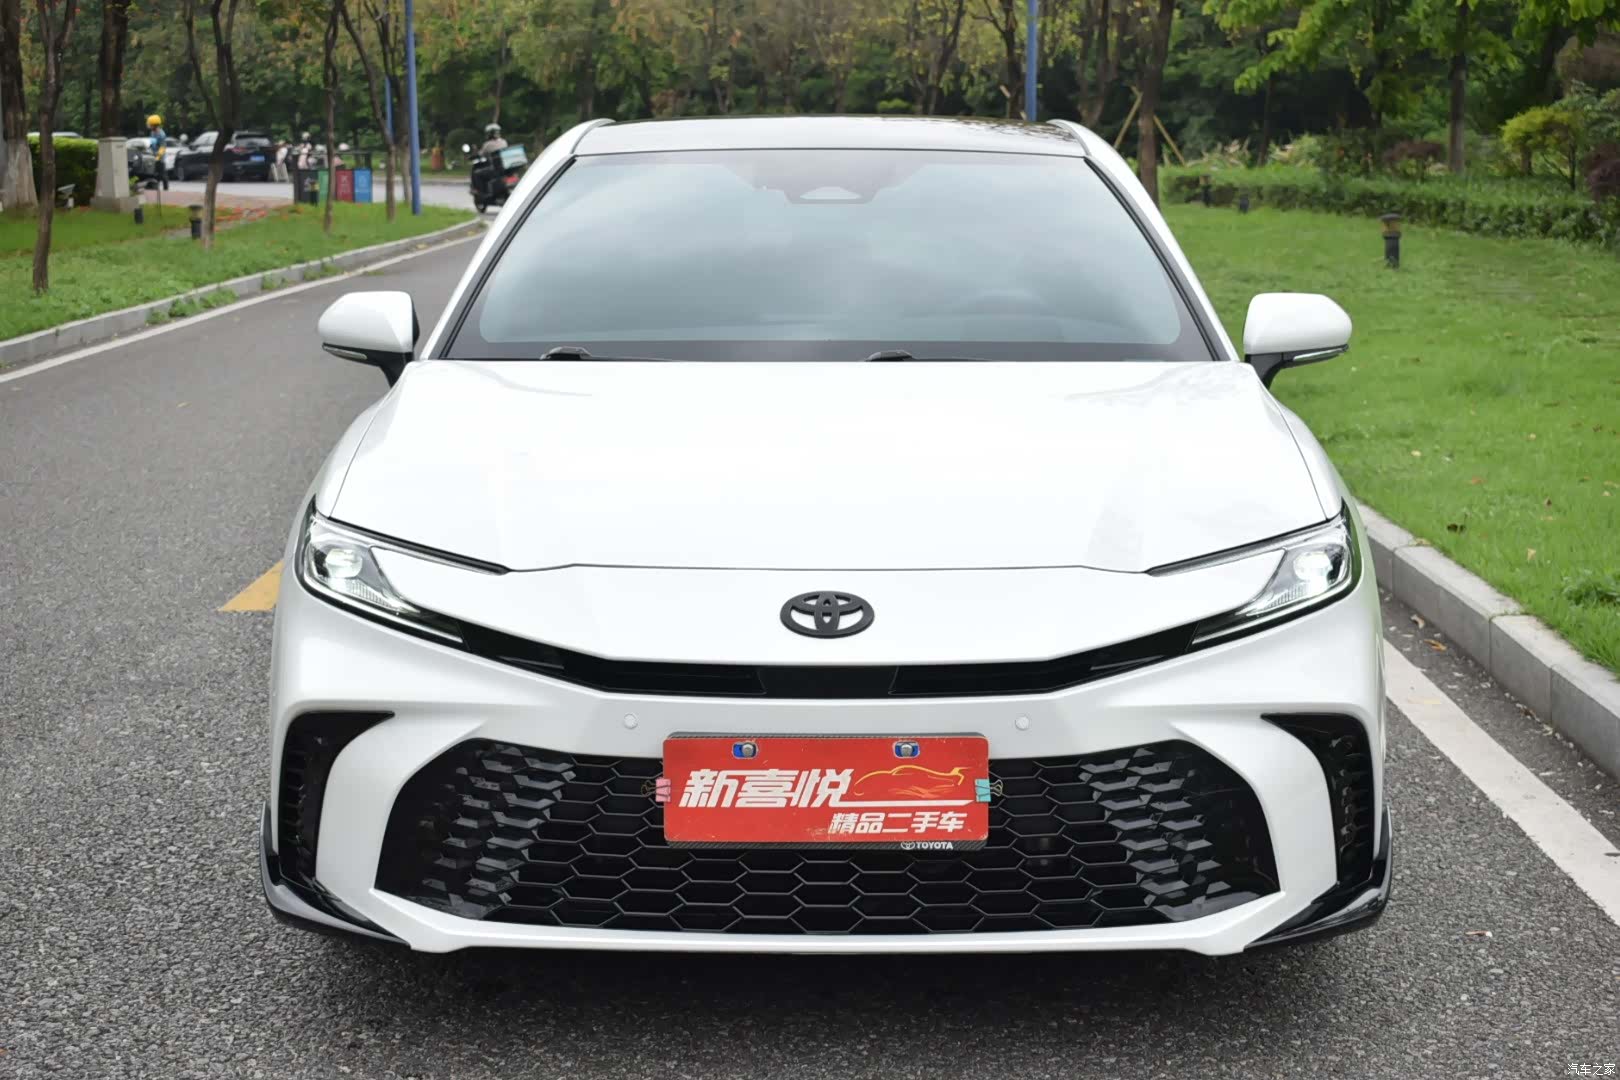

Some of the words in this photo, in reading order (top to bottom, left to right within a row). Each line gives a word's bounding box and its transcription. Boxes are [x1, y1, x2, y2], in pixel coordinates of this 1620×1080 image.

[679, 769, 854, 808] 新喜悦
[828, 811, 968, 833] 精品二手车
[916, 841, 953, 850] TOYOTA
